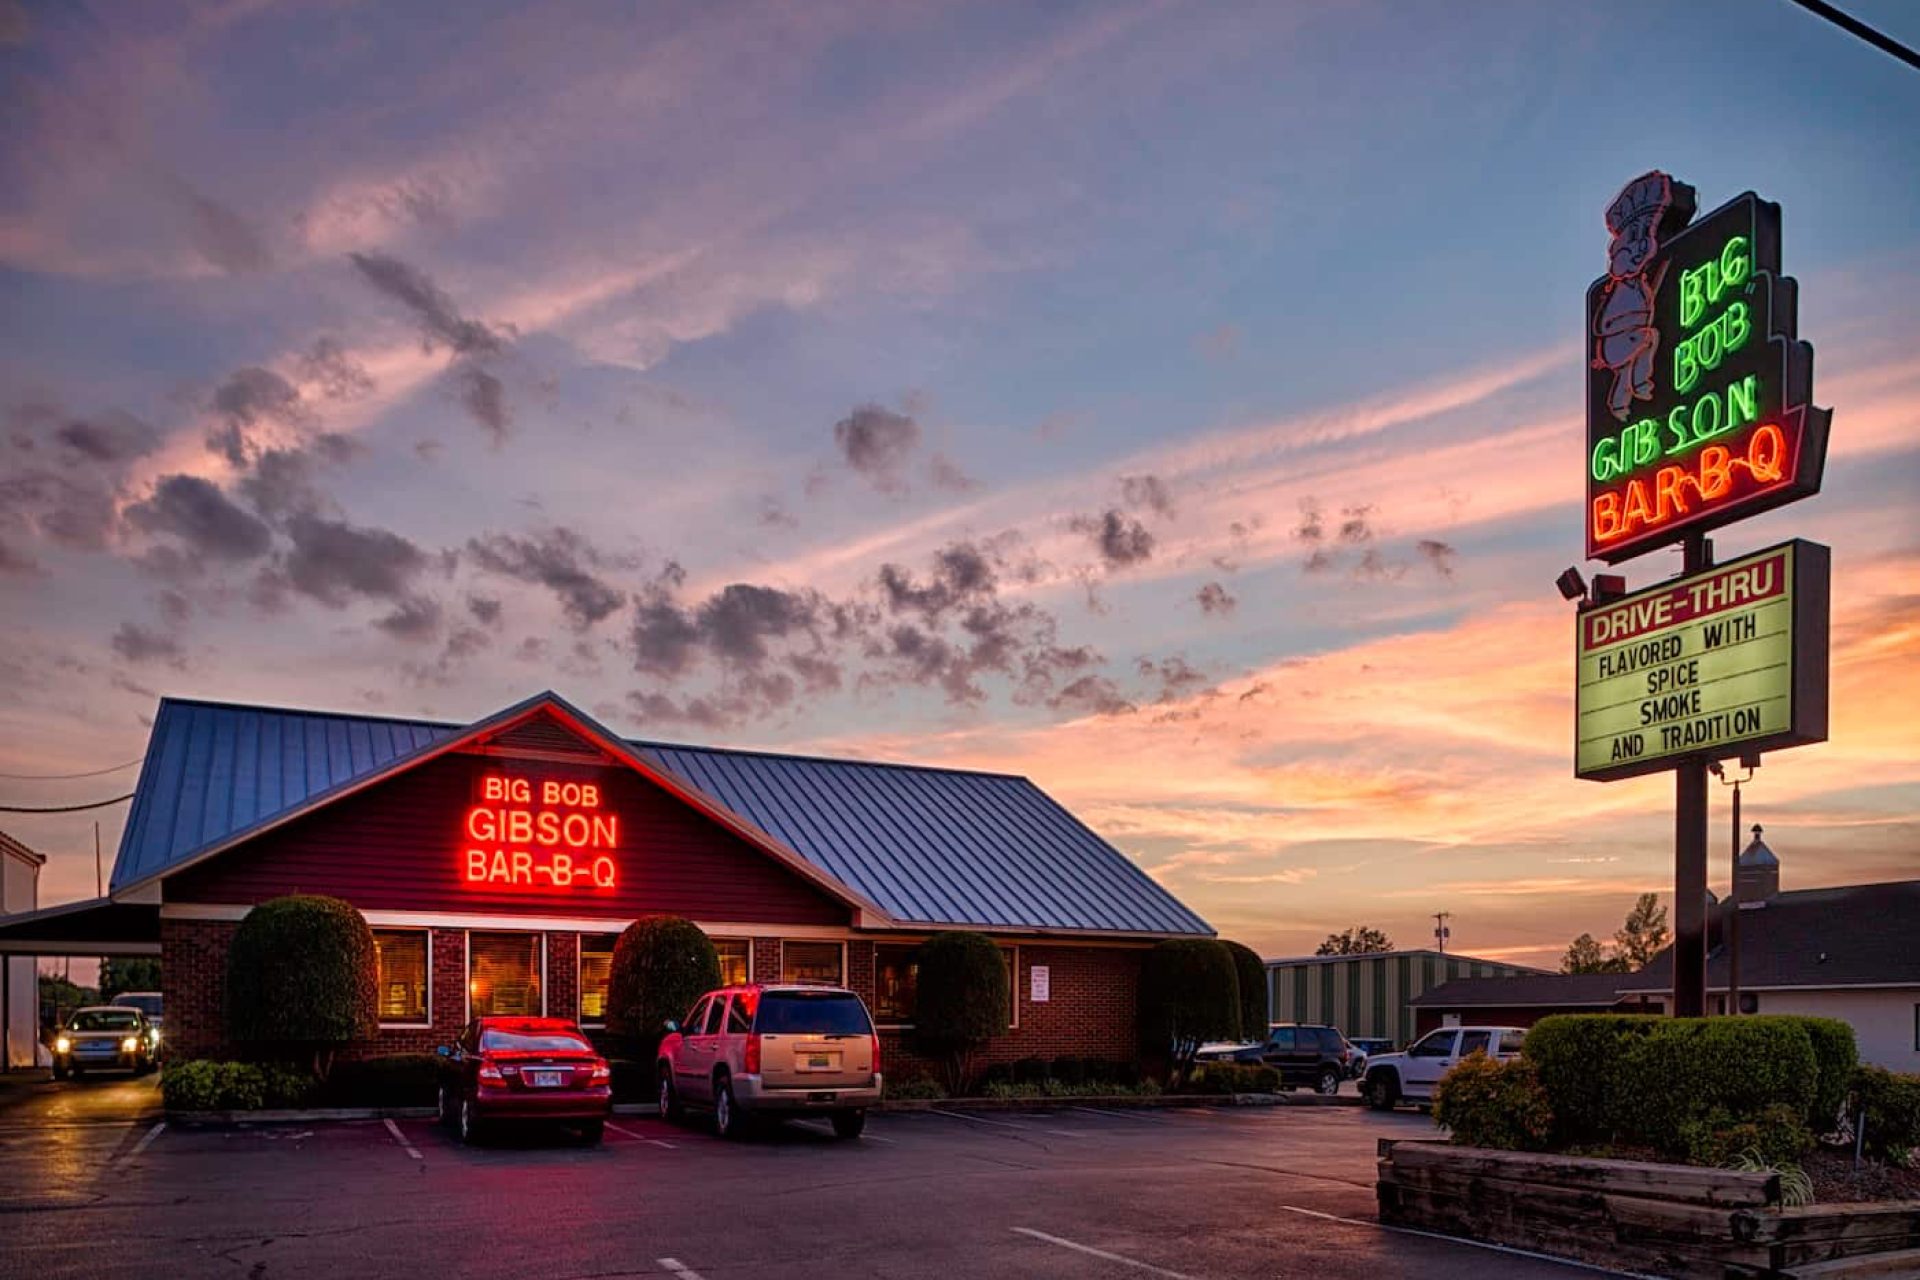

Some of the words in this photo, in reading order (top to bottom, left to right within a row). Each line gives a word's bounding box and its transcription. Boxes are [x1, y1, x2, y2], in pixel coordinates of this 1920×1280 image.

[1680, 236, 1749, 328] BIG
[1674, 302, 1750, 394] BOB
[1592, 375, 1757, 481] GIBSON
[1593, 424, 1786, 542] BAR-B-Q
[1592, 562, 1774, 645] DRIVE-THRU
[1599, 634, 1682, 678] FLAVORED
[1703, 613, 1755, 649] WITH
[1647, 660, 1698, 694] SPICE
[1612, 734, 1644, 761] AND
[1661, 706, 1760, 750] TRADITION
[1640, 691, 1701, 725] SMOKE
[486, 777, 531, 803] BIG
[543, 781, 599, 807] BOB
[468, 808, 617, 848] GIBSON
[467, 850, 615, 888] BAR-B-Q
